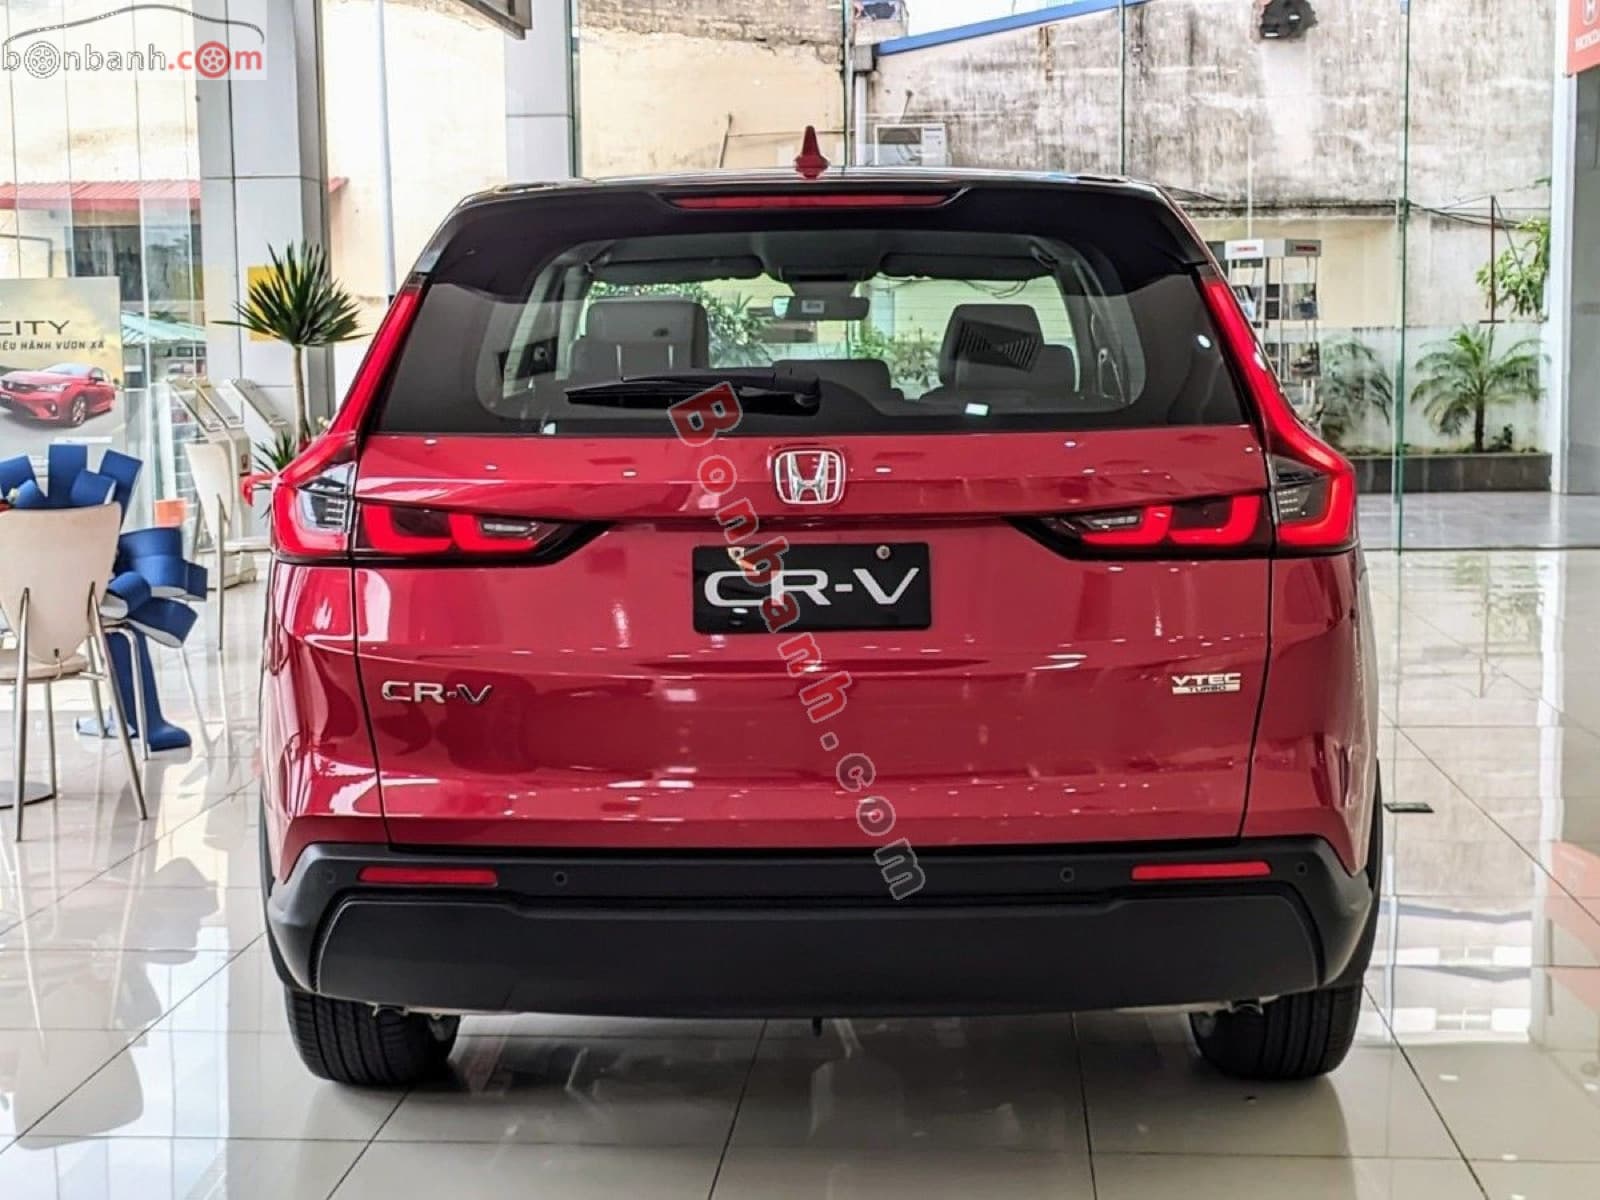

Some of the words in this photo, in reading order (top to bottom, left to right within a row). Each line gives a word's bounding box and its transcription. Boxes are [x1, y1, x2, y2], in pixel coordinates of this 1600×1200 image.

[704, 567, 920, 607] CR-V
[1171, 672, 1242, 686] VTEC
[382, 680, 492, 704] CR-V
